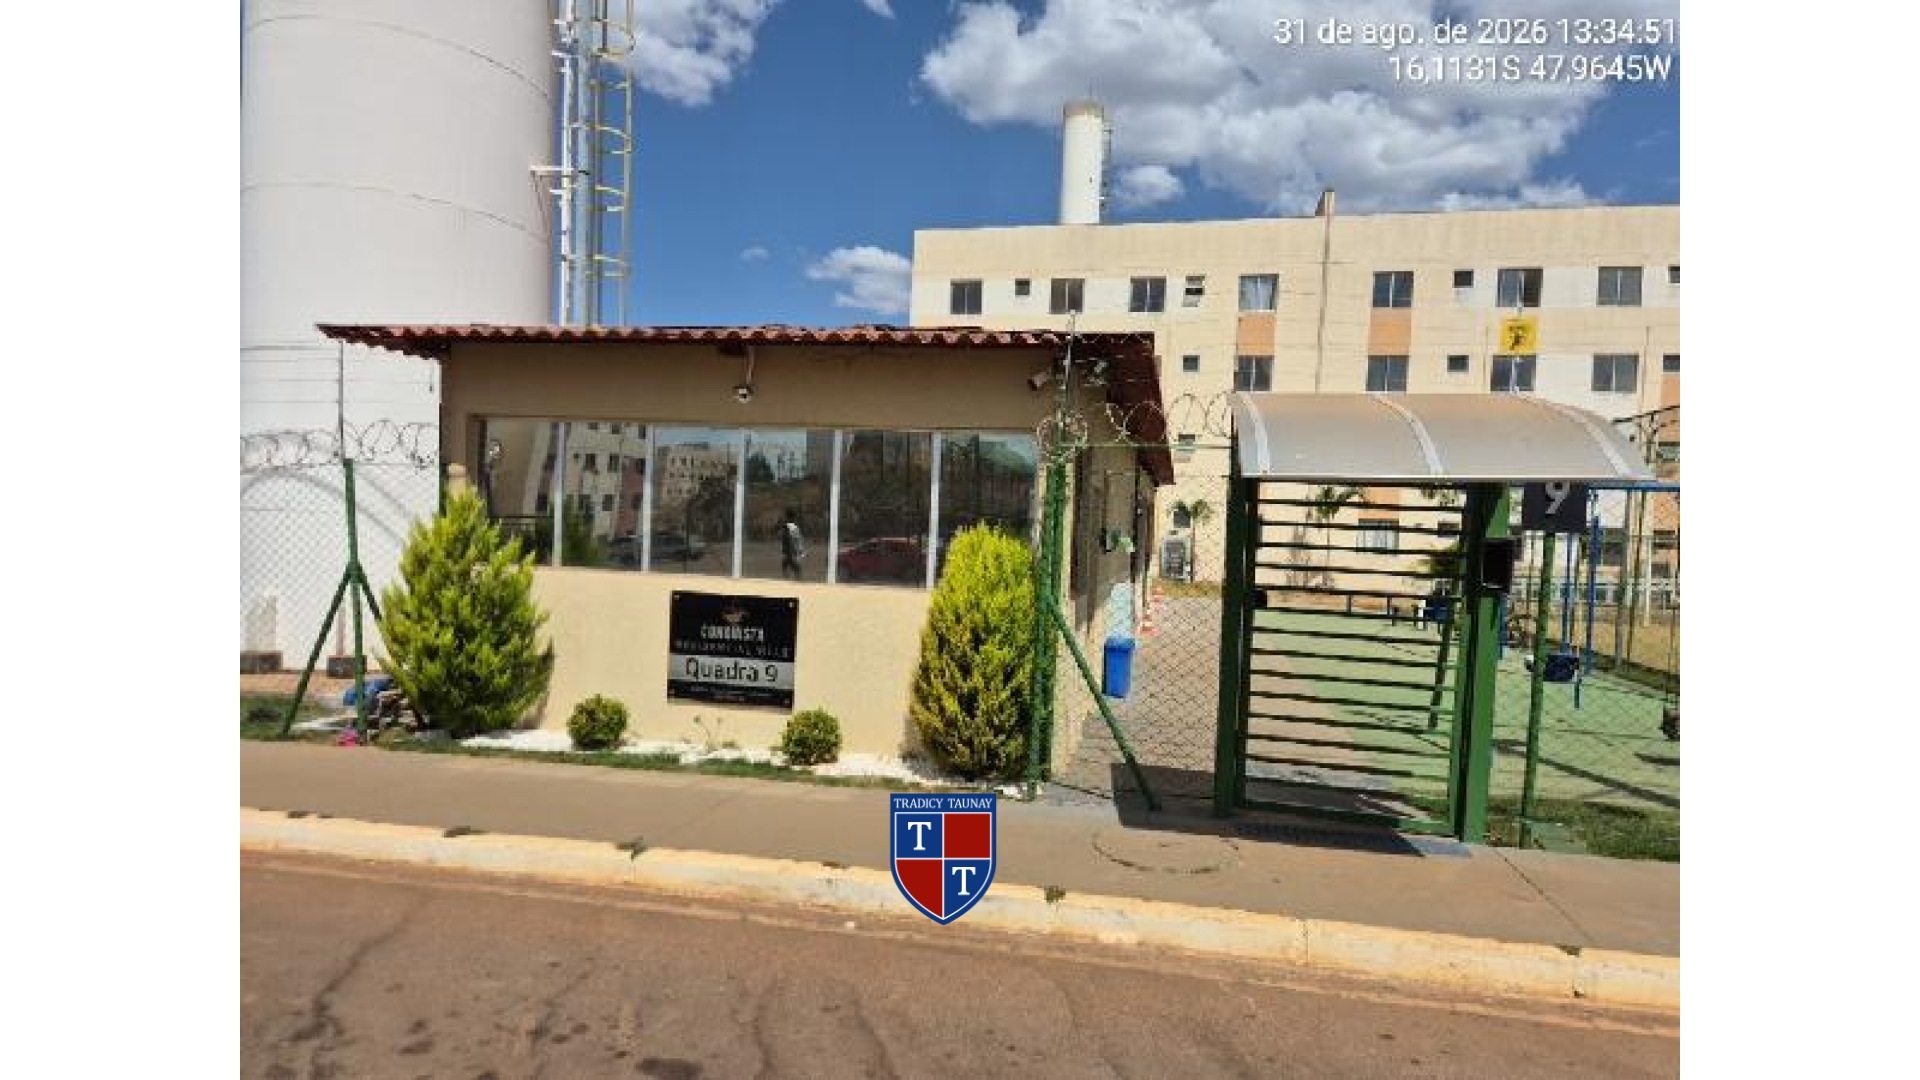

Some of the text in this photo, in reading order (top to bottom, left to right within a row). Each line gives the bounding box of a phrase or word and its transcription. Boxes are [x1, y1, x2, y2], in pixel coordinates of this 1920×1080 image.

[1545, 480, 1570, 514] 9
[685, 656, 779, 683] Quadra 9
